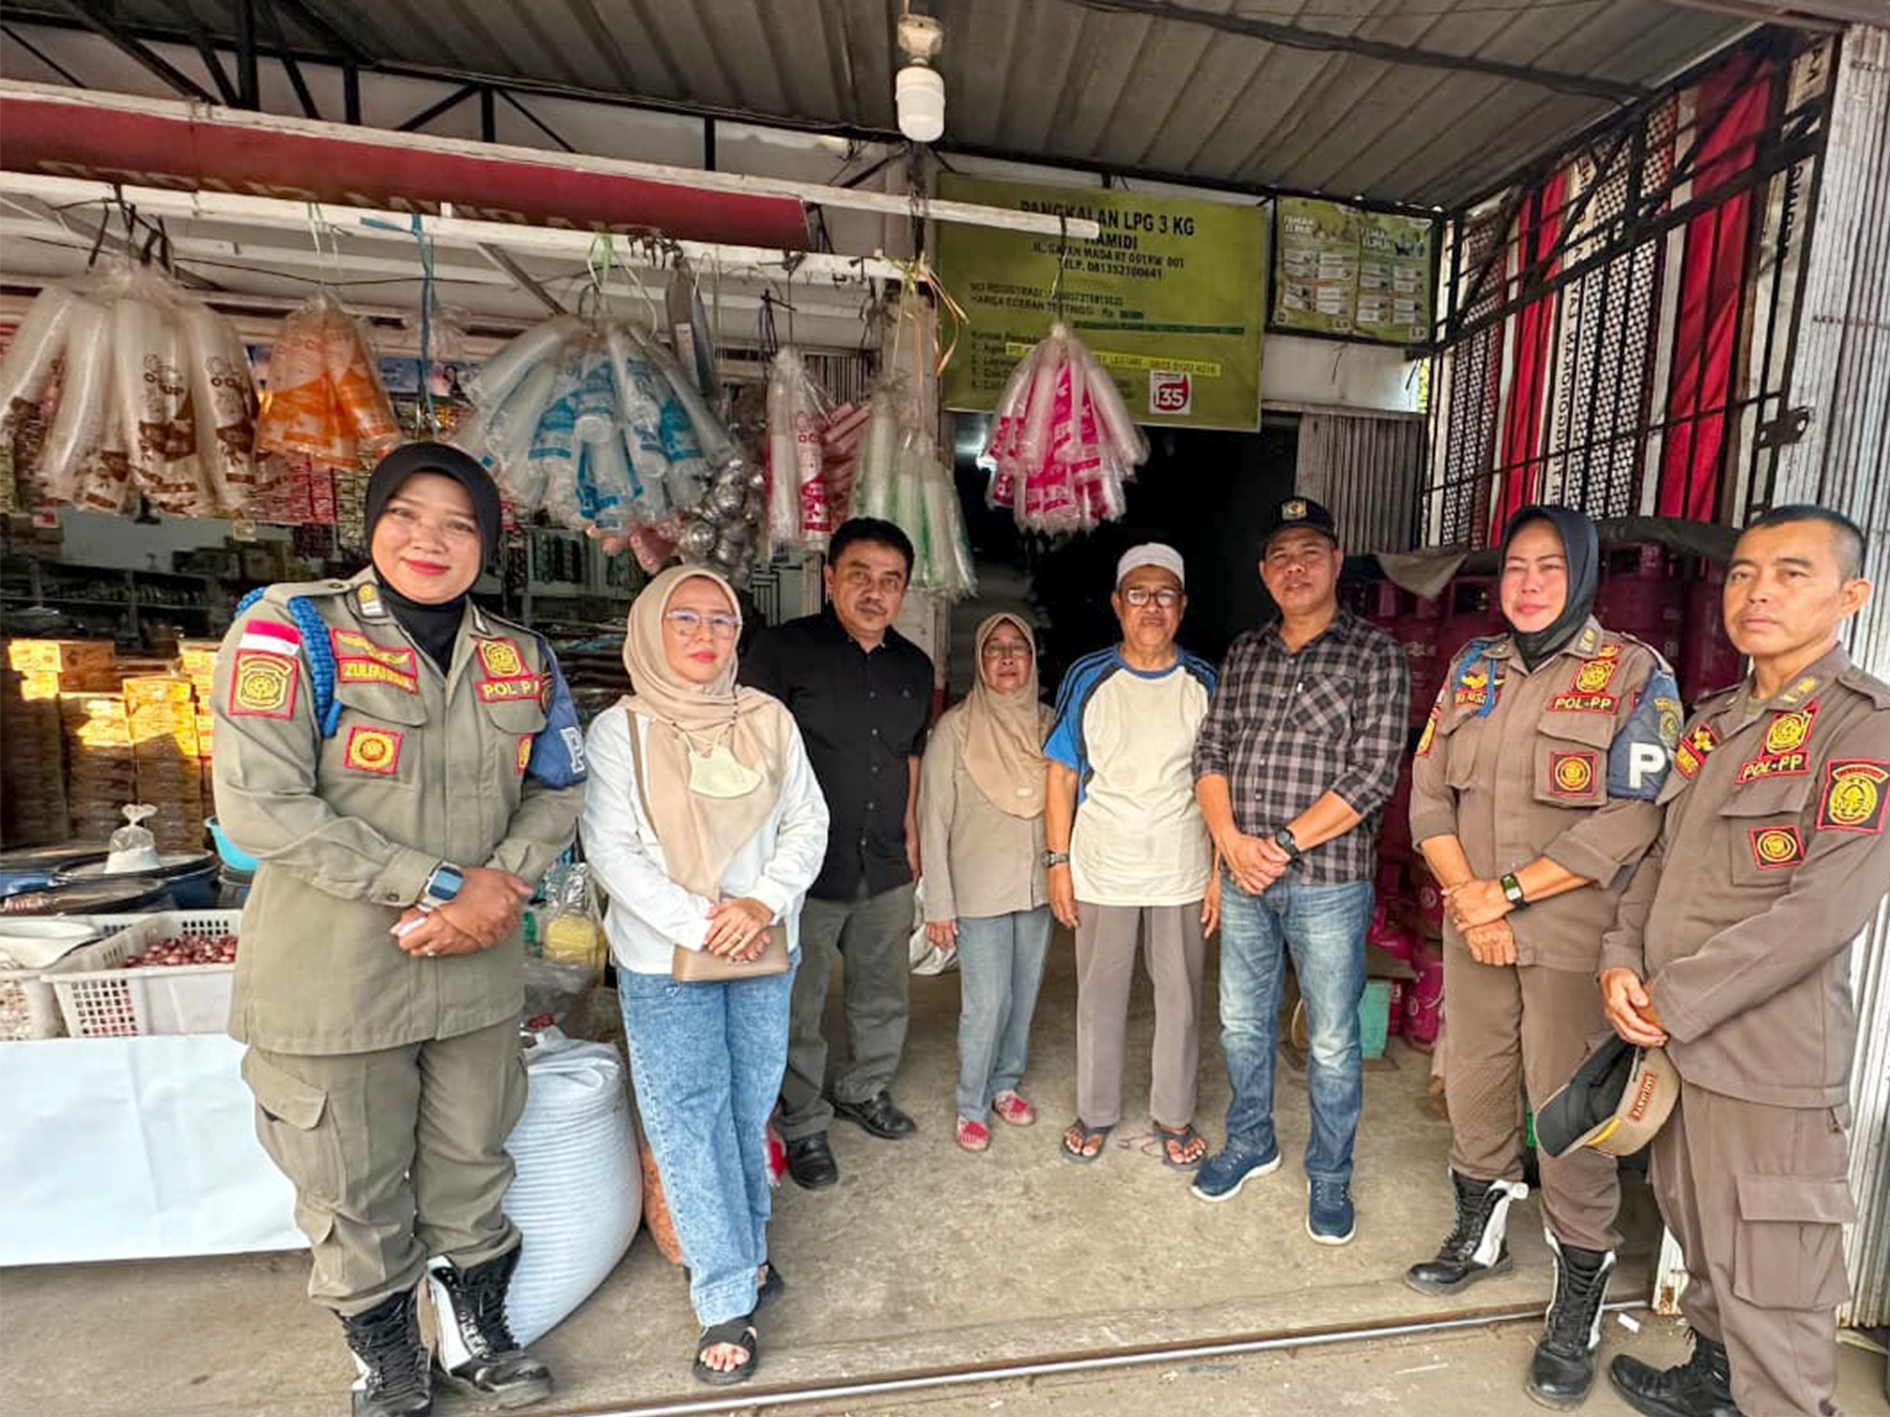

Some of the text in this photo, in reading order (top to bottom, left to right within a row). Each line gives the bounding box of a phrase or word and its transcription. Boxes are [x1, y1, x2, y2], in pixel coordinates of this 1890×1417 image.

[1124, 212, 1154, 232] LPG
[1158, 215, 1168, 233] 3
[1173, 216, 1195, 236] KG
[1154, 386, 1185, 407] 135
[483, 682, 516, 700] POL
[1554, 698, 1613, 710] POL-PP
[1629, 741, 1666, 789] P
[1744, 754, 1803, 778] POL-PP
